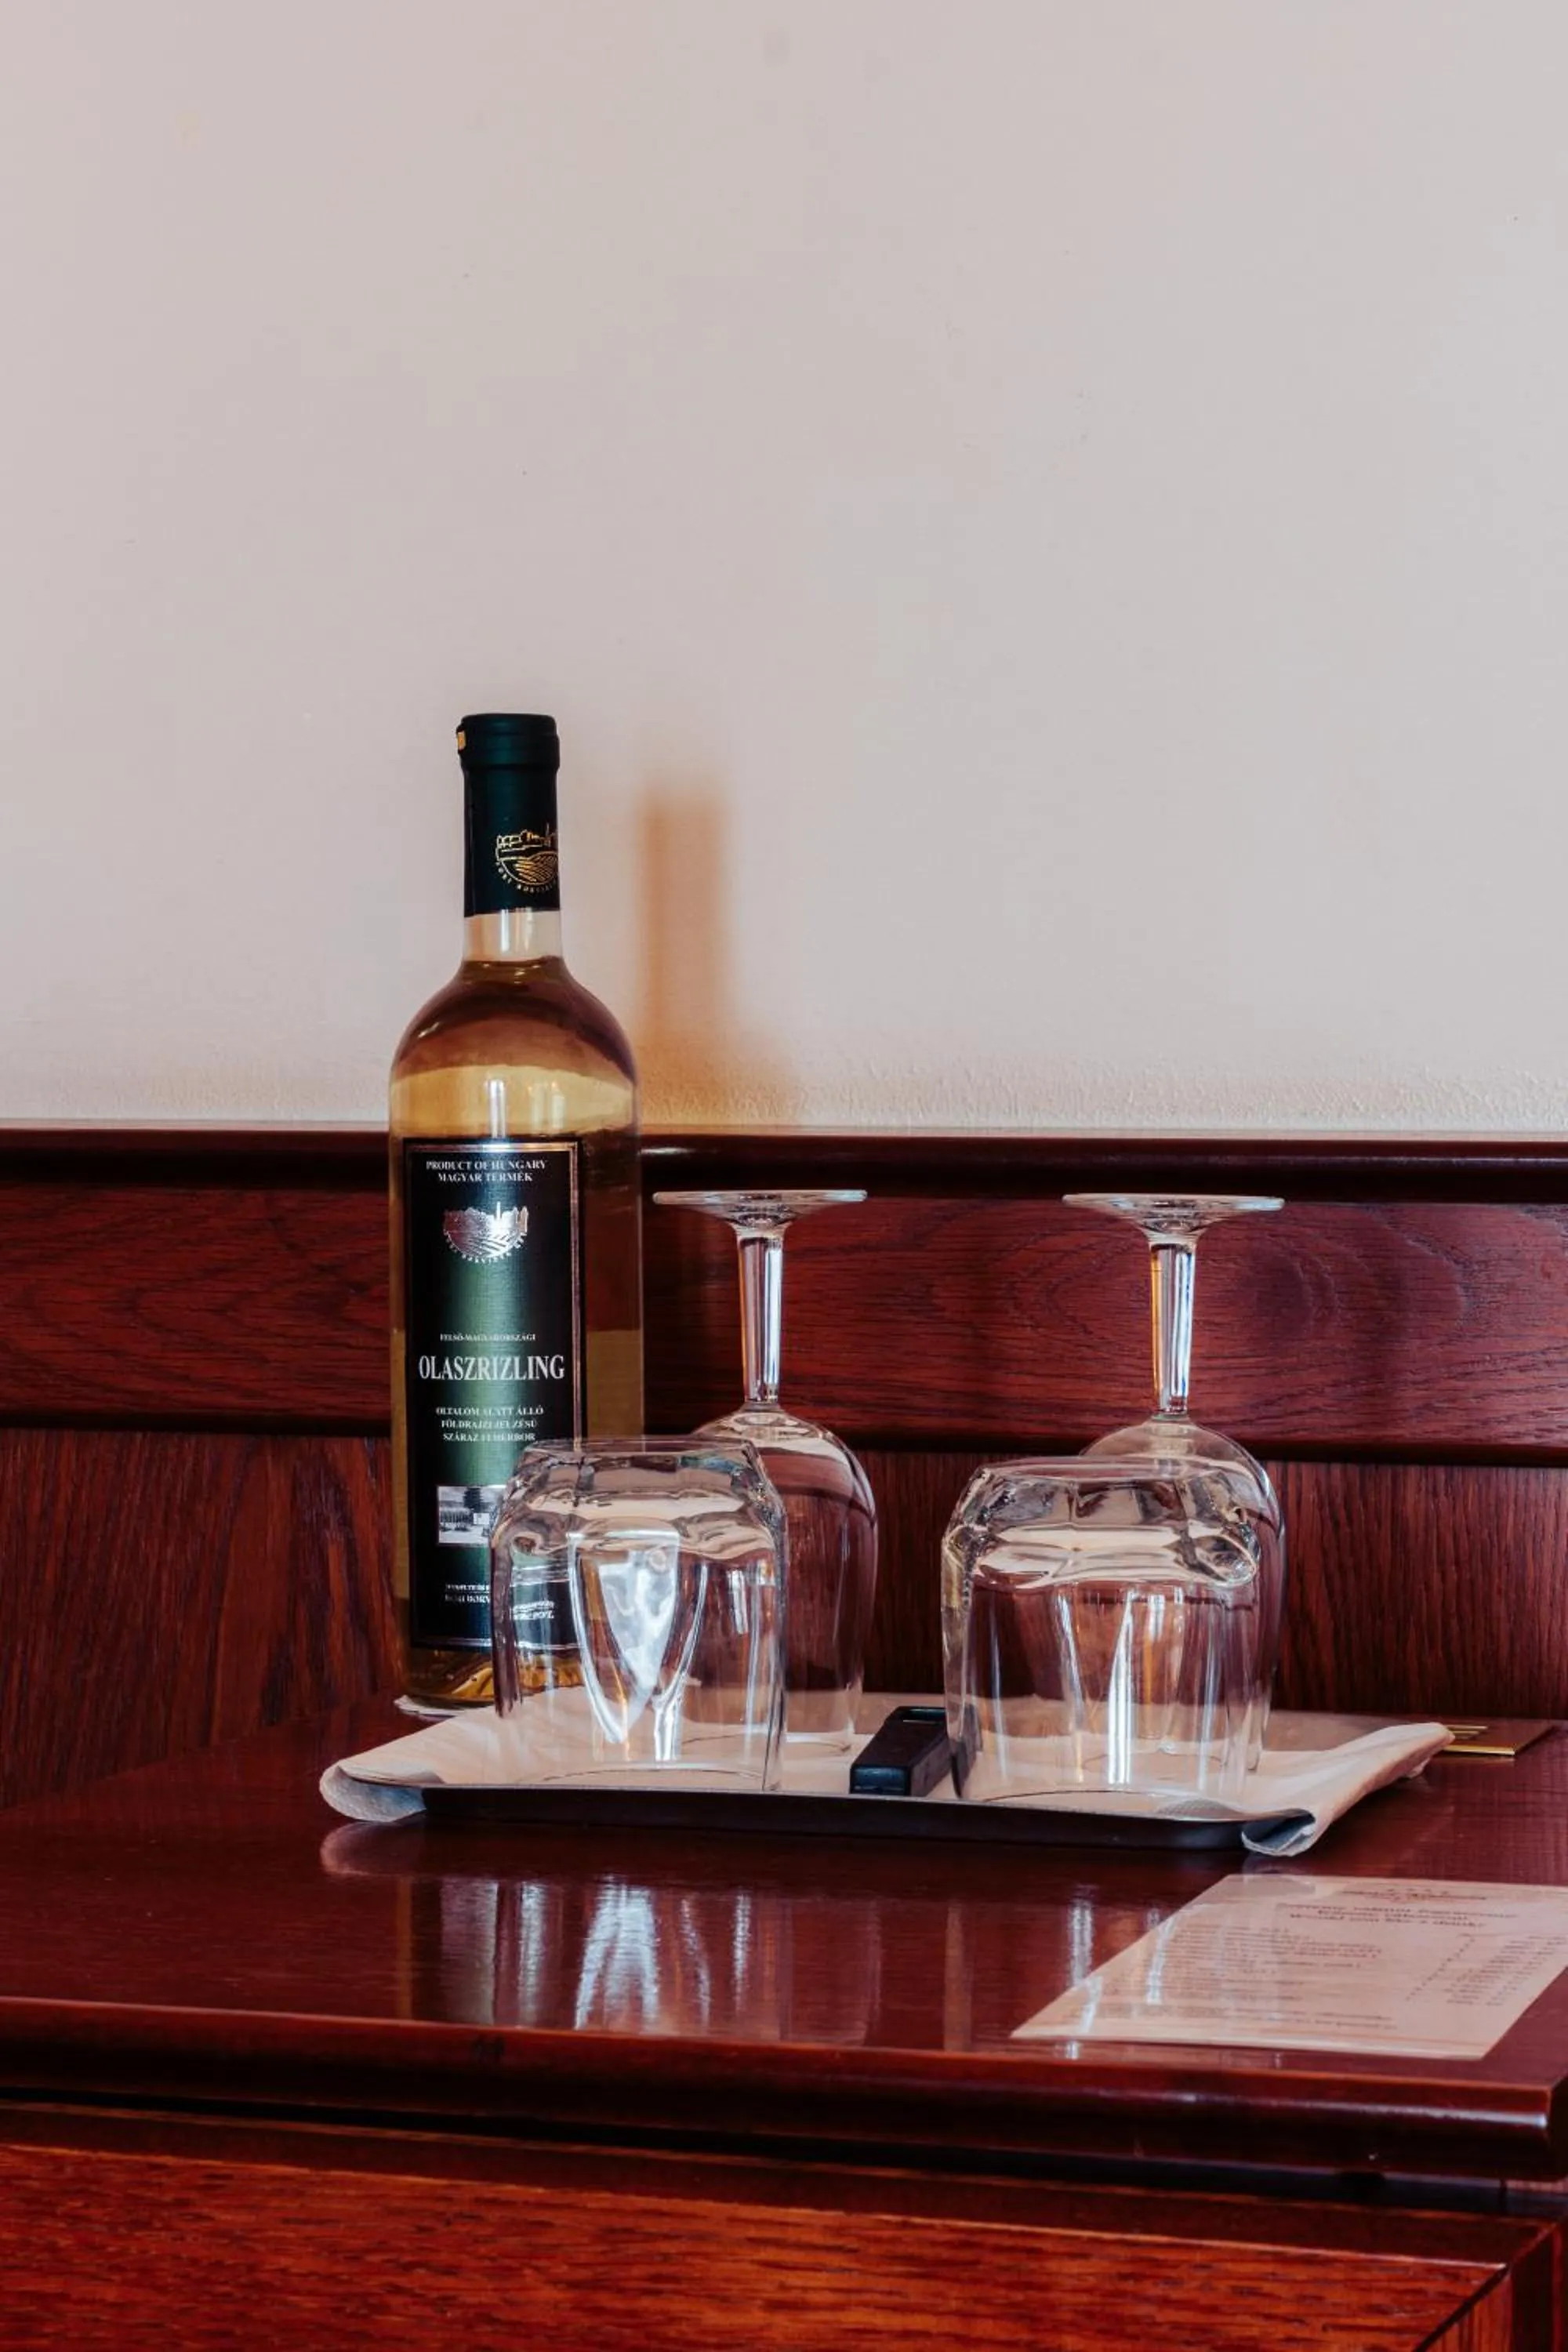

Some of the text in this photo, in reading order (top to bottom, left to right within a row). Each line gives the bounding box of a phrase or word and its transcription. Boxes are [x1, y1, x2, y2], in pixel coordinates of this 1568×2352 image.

[426, 1160, 471, 1171] PRODUCT
[491, 1160, 547, 1170] HUNGARY
[437, 1173, 483, 1183] MAGYAR
[419, 1355, 565, 1381] OLASZRIZLING
